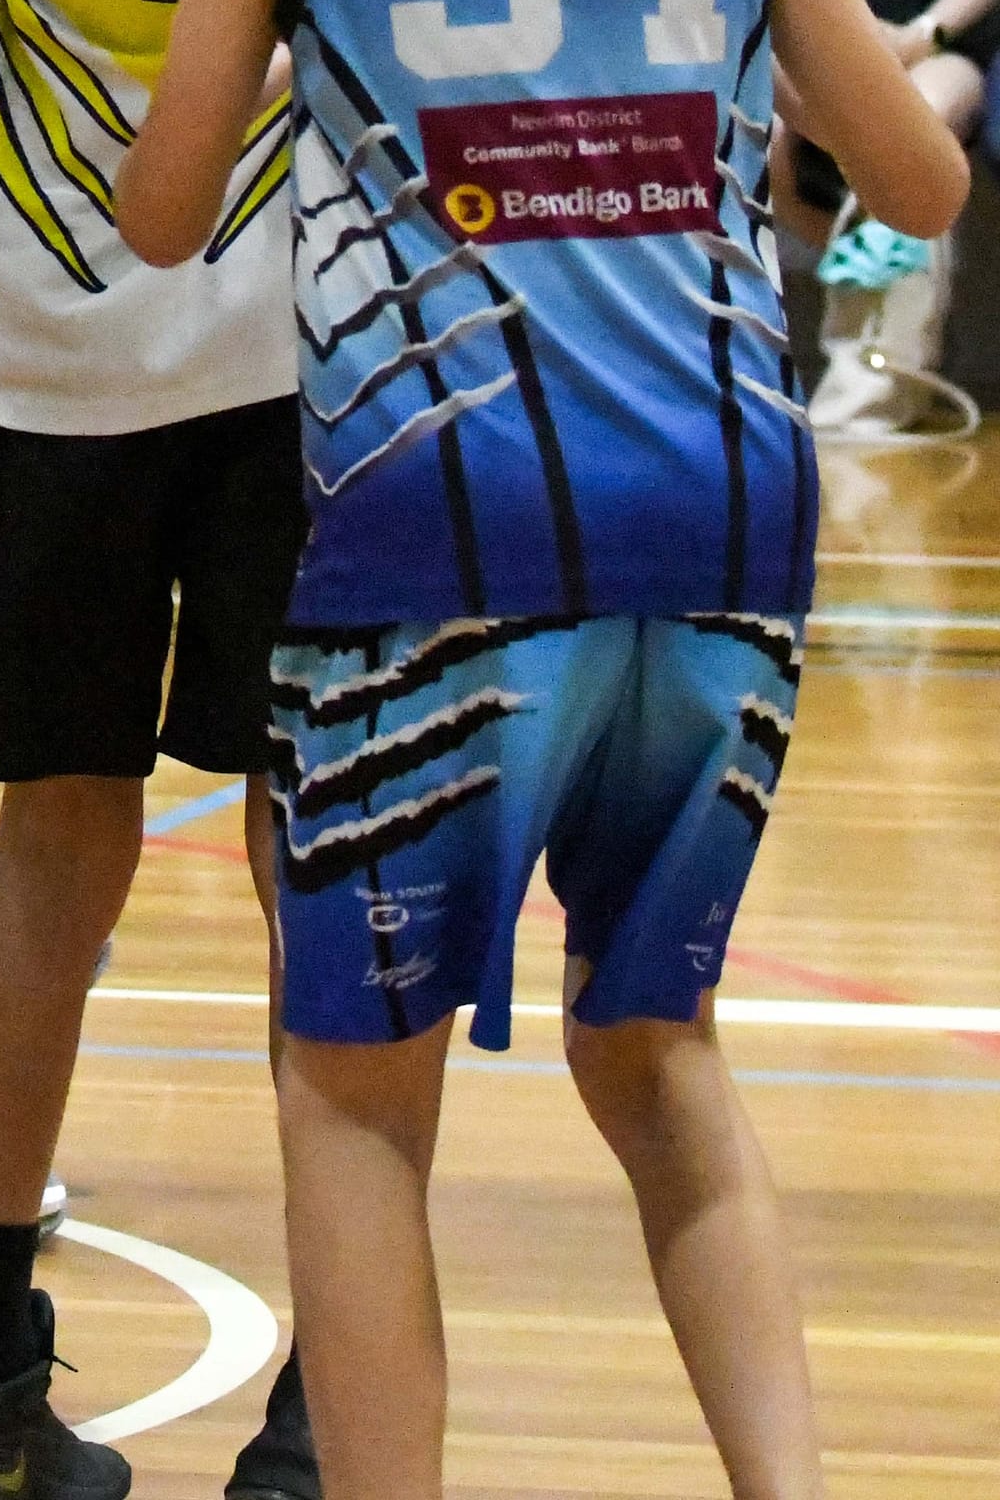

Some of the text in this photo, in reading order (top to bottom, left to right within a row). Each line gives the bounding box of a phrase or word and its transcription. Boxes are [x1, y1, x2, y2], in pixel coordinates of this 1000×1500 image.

[463, 139, 572, 165] Community
[501, 181, 709, 222] Bendigo Bank
